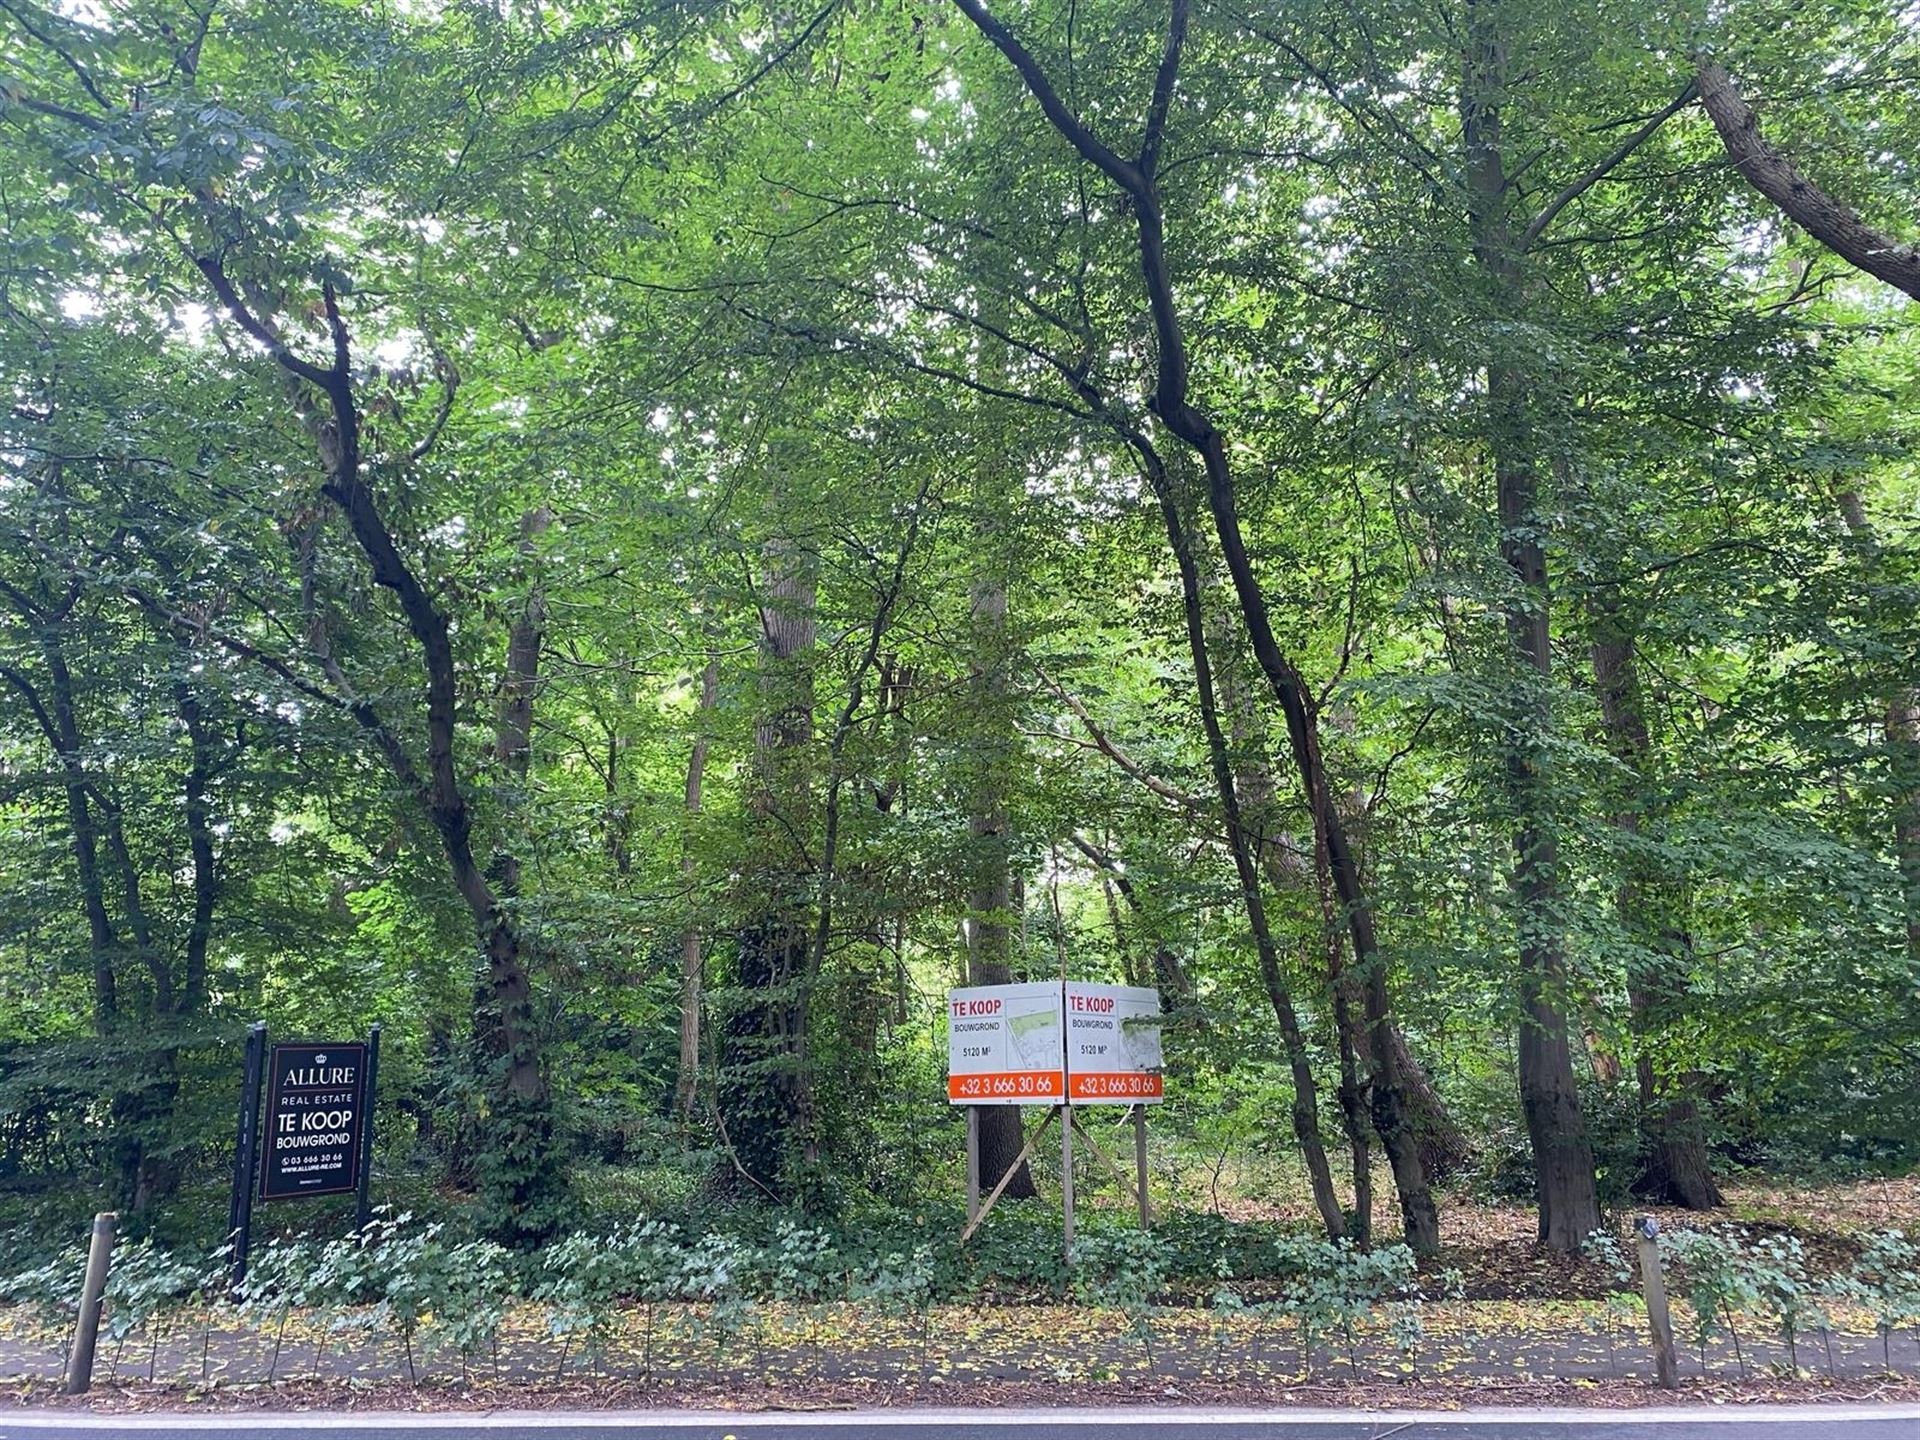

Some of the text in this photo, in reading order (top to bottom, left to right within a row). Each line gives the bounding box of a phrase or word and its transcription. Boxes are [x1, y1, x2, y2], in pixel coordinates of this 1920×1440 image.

[952, 999, 1001, 1016] TE KOOP
[1070, 996, 1114, 1012] TE KOOP
[955, 1022, 1000, 1032] BOUWGROND
[1073, 1019, 1113, 1030] BOUWGROND
[963, 1047, 980, 1056] 5120
[1081, 1045, 1096, 1054] 5120
[283, 1067, 354, 1087] ALLURE
[960, 1077, 1051, 1094] +32 3 666 30 66
[1079, 1078, 1153, 1094] +32 3 666 30 66
[282, 1094, 352, 1105] REAL ESTATE
[278, 1110, 352, 1132] TE KOOP
[276, 1132, 350, 1149] BOUWGROND
[291, 1153, 342, 1165] 03 666 30 66
